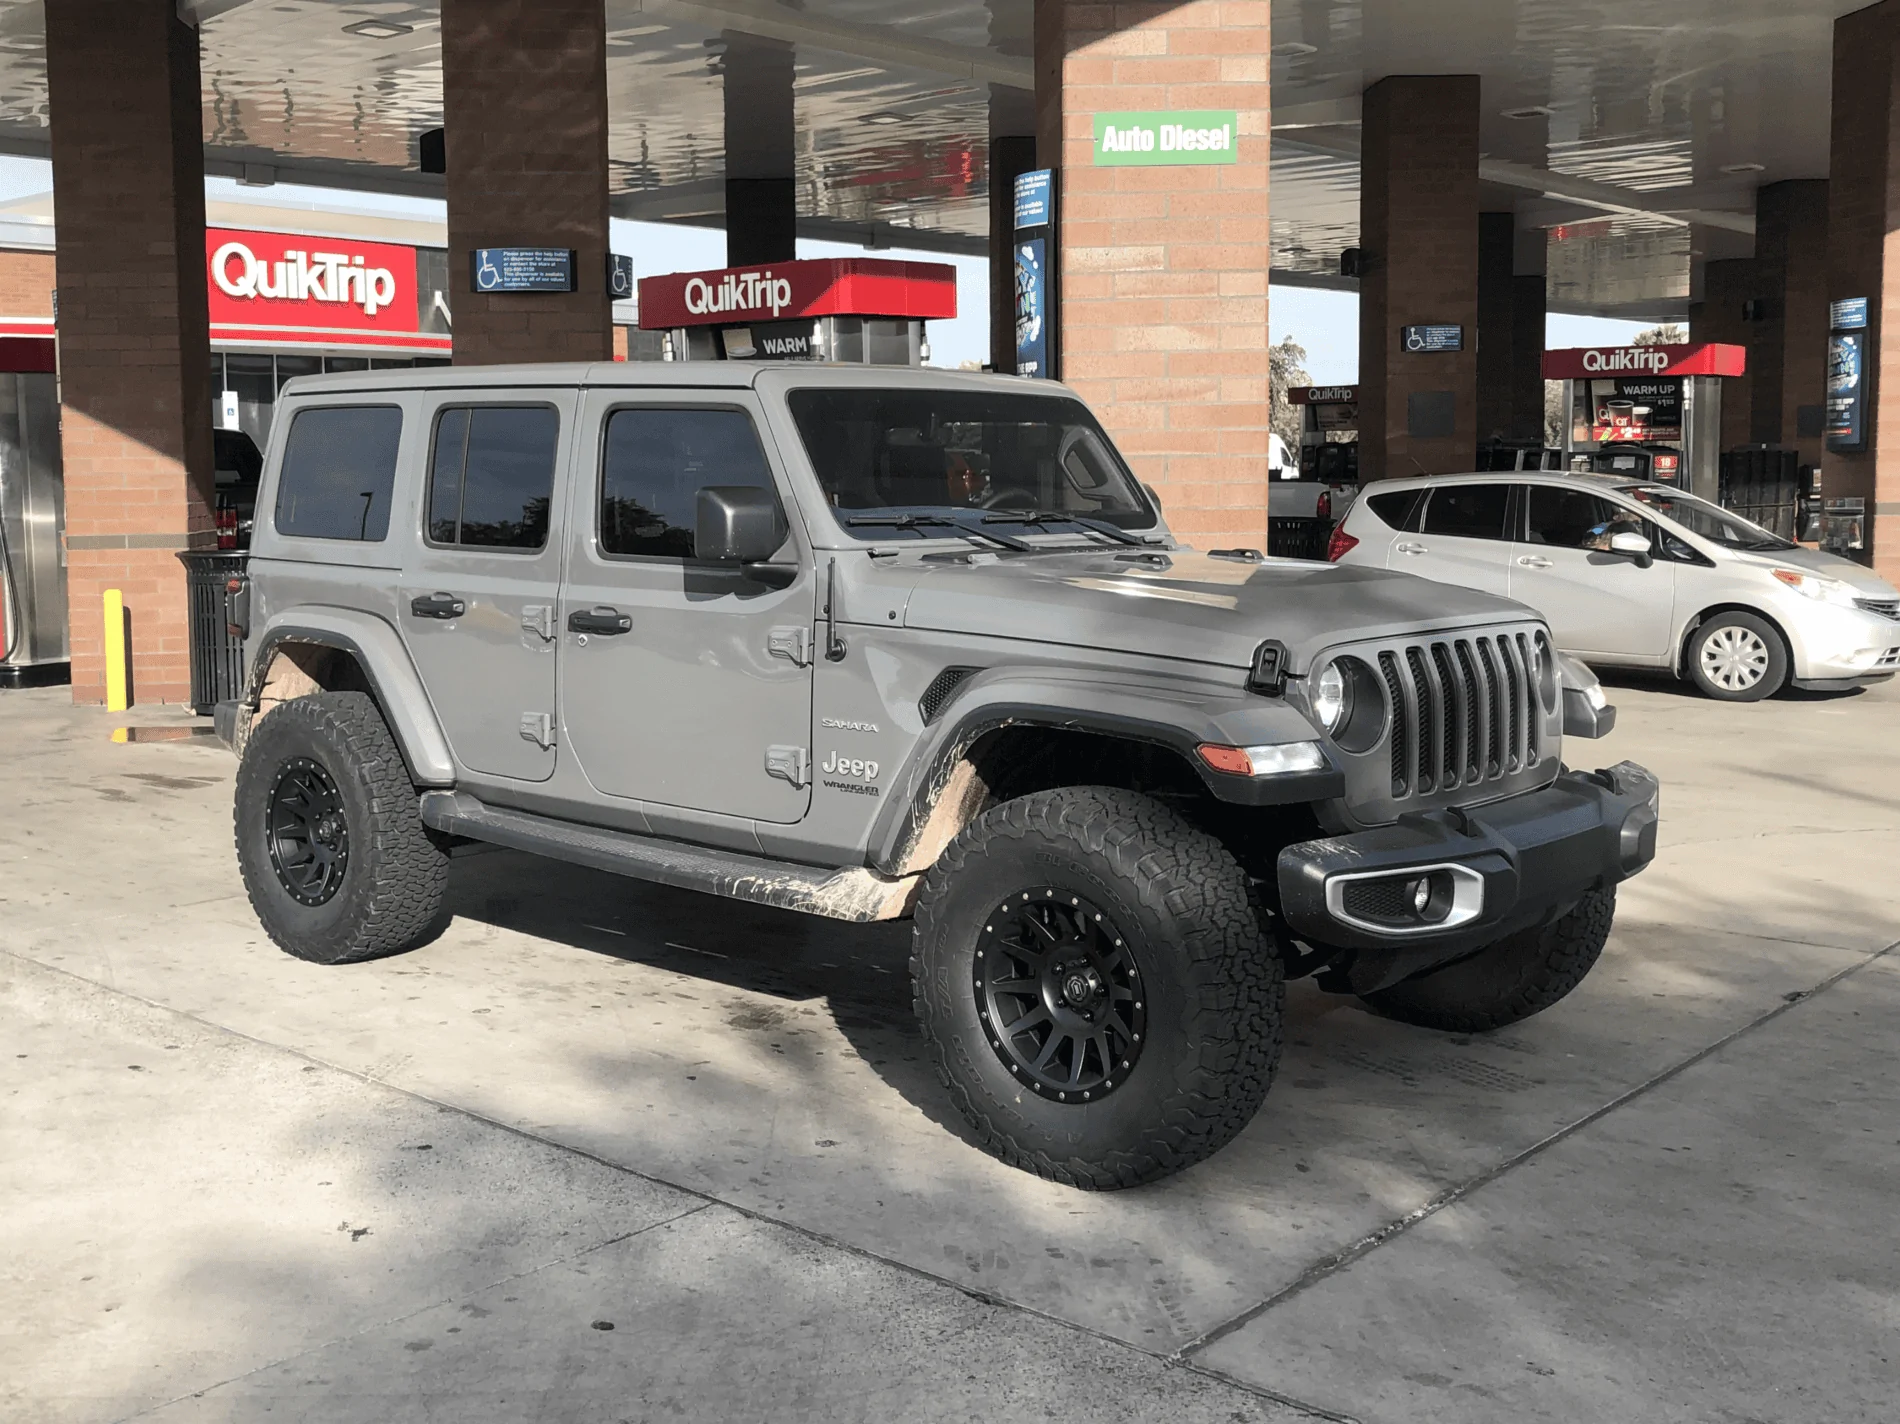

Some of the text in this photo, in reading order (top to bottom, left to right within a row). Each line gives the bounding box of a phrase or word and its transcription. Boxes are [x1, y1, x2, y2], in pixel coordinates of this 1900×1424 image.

[1102, 124, 1230, 152] Auto Diesel
[211, 242, 396, 315] QuikTrip
[685, 271, 792, 317] QuikTrip
[763, 336, 807, 354] WARM
[1583, 348, 1668, 374] QuikTrip
[1308, 387, 1352, 402] QuikTrip
[1623, 385, 1675, 395] WARM UP
[1616, 418, 1628, 426] QT
[1660, 457, 1671, 467] 18
[822, 718, 879, 733] SAHARA
[822, 750, 879, 783] Jeep
[823, 780, 879, 793] WRANGLER
